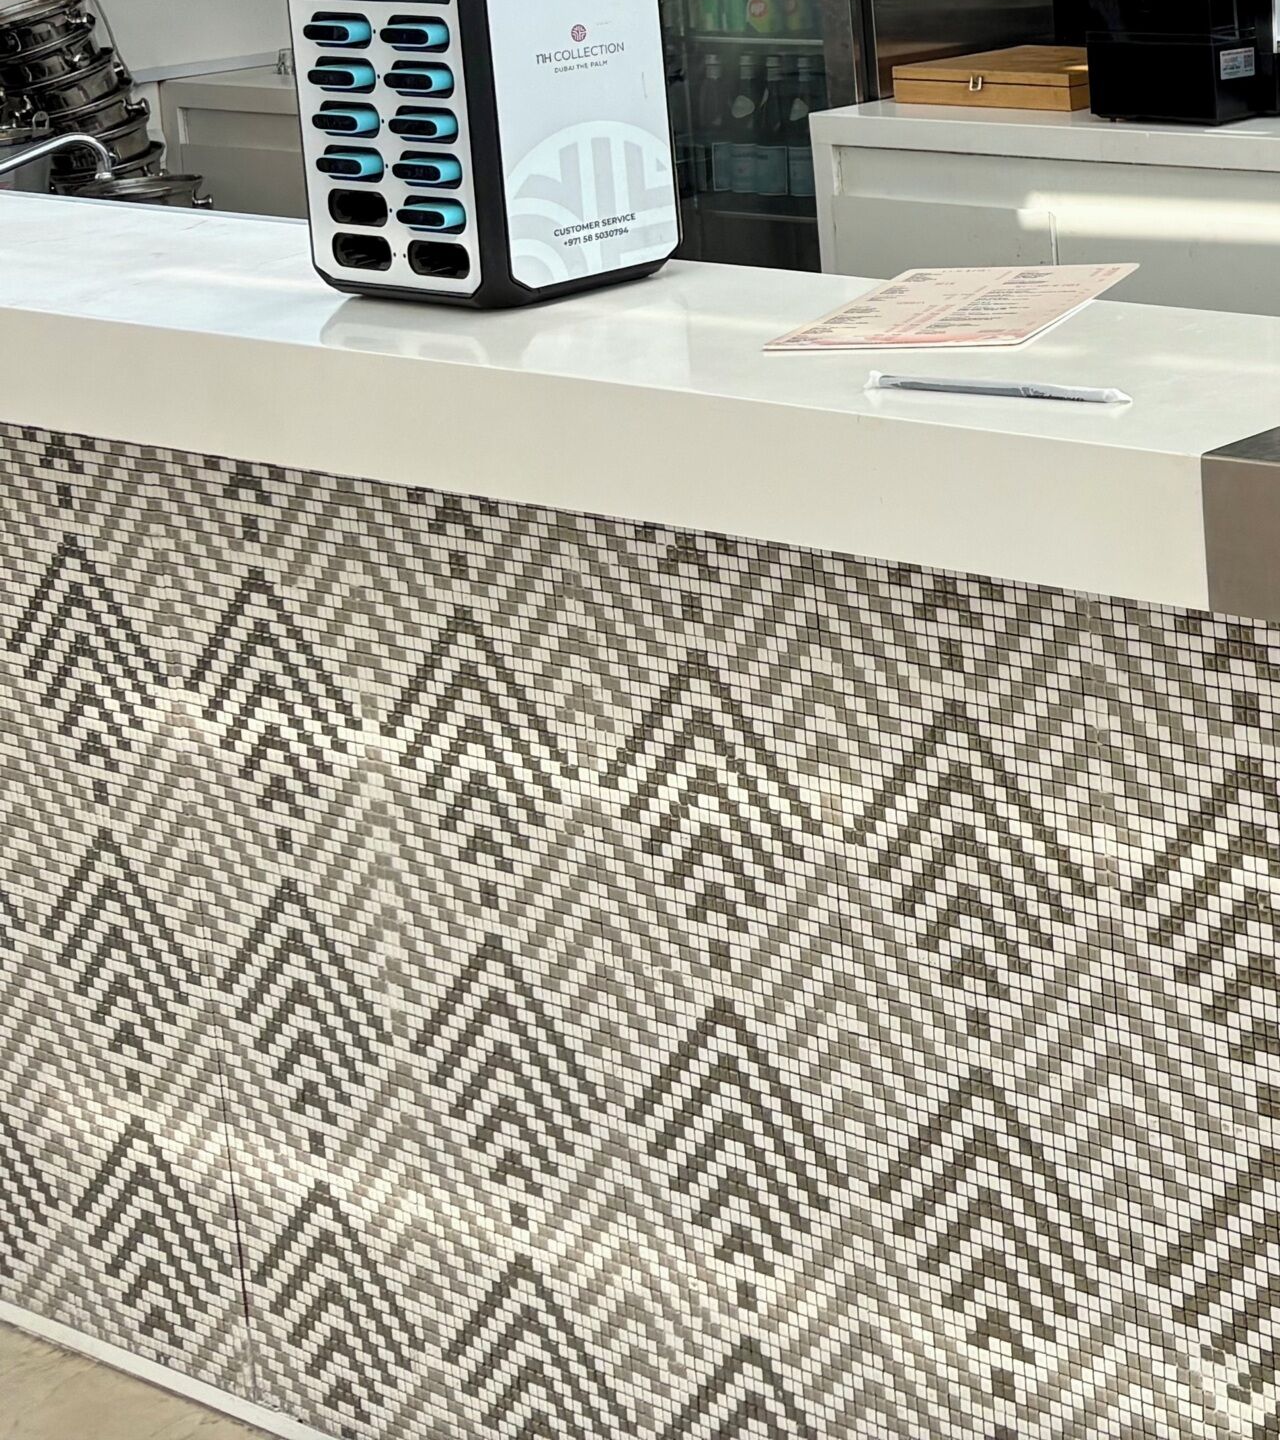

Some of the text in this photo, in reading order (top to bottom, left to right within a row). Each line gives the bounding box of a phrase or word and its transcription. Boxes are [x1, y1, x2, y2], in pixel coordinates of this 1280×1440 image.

[553, 41, 625, 62] COLLECTION
[554, 59, 608, 74] DUBAI THE PALM
[553, 212, 636, 237] CUSTOMER SERVICE
[563, 226, 629, 247] +971 58 5030794
